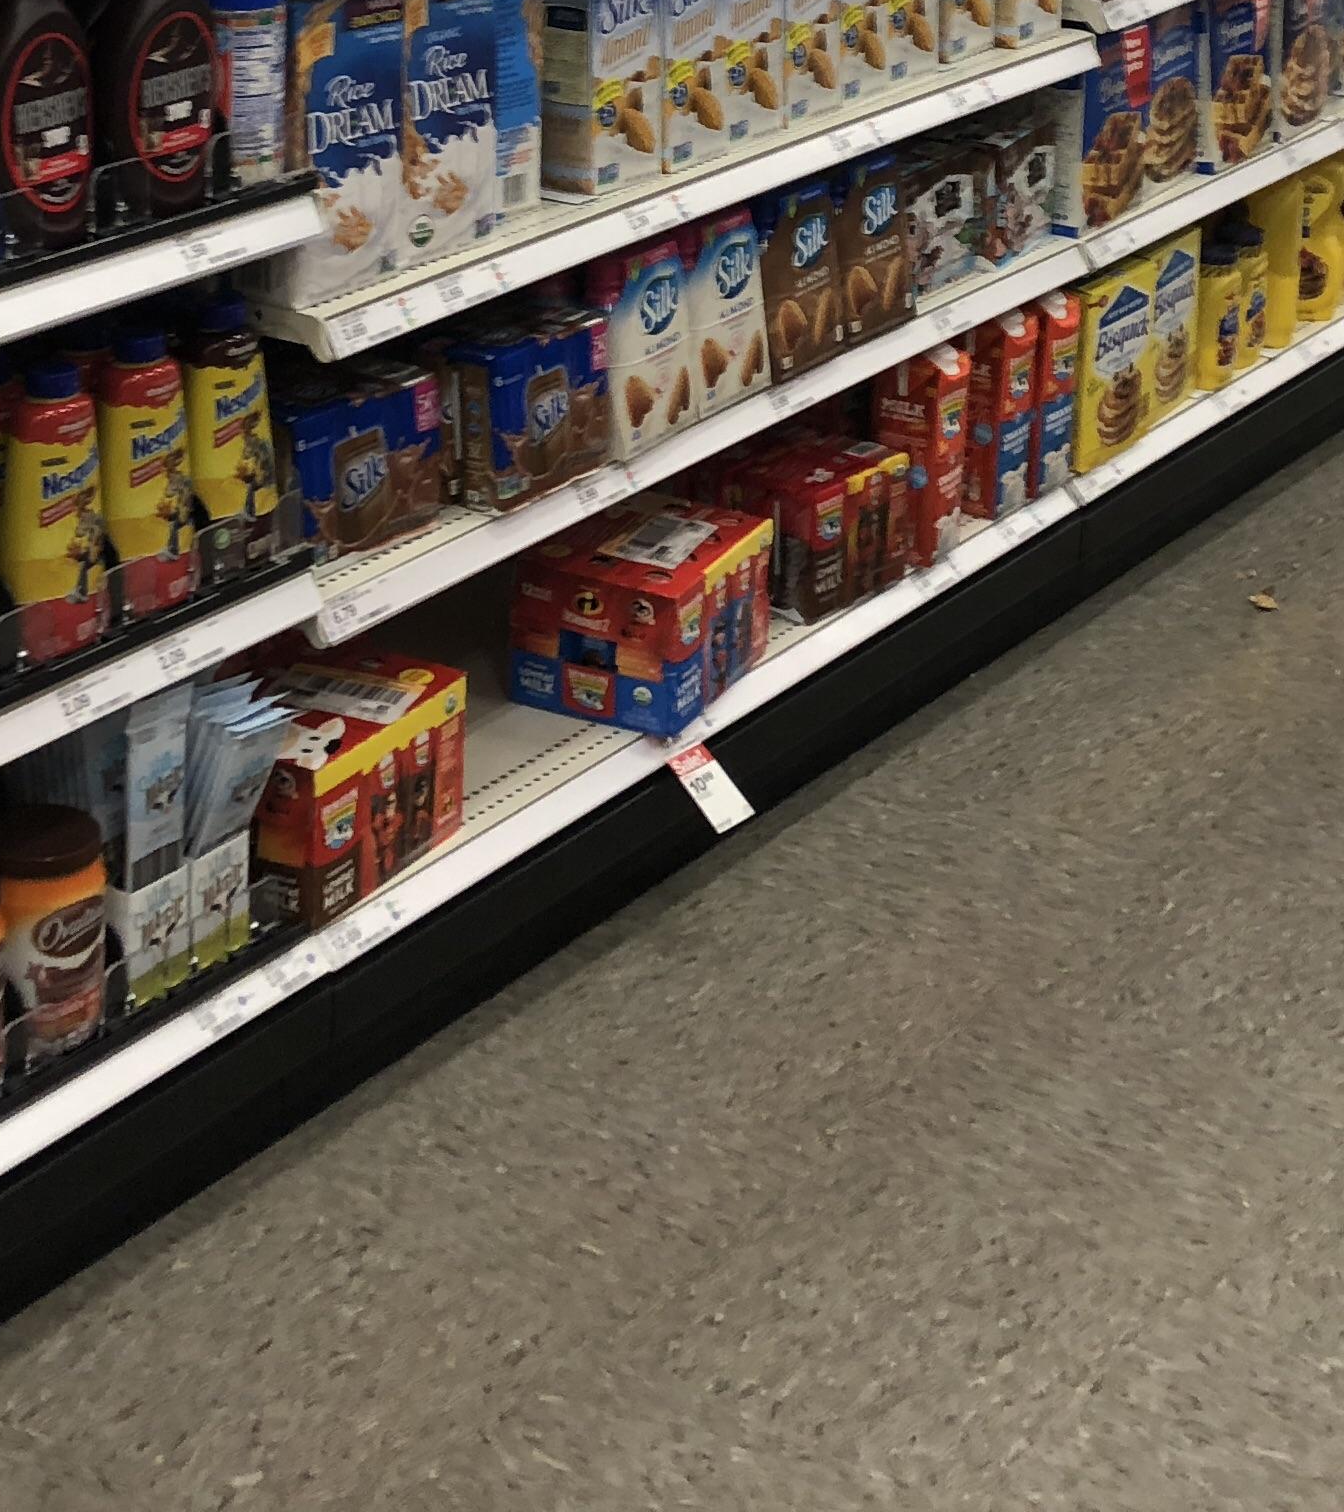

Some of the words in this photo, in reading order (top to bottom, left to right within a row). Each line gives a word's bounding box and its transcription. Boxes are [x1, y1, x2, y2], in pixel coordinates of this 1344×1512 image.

[423, 44, 469, 79] Rice
[324, 74, 375, 109] Rice
[407, 68, 493, 122] DREAM
[305, 97, 398, 156] DREAM
[861, 186, 899, 236] Silk
[791, 215, 829, 268] Silk
[716, 245, 754, 297] Silk
[640, 275, 680, 335] Silk
[1094, 317, 1150, 362] Bisquick
[340, 452, 387, 511] Silk
